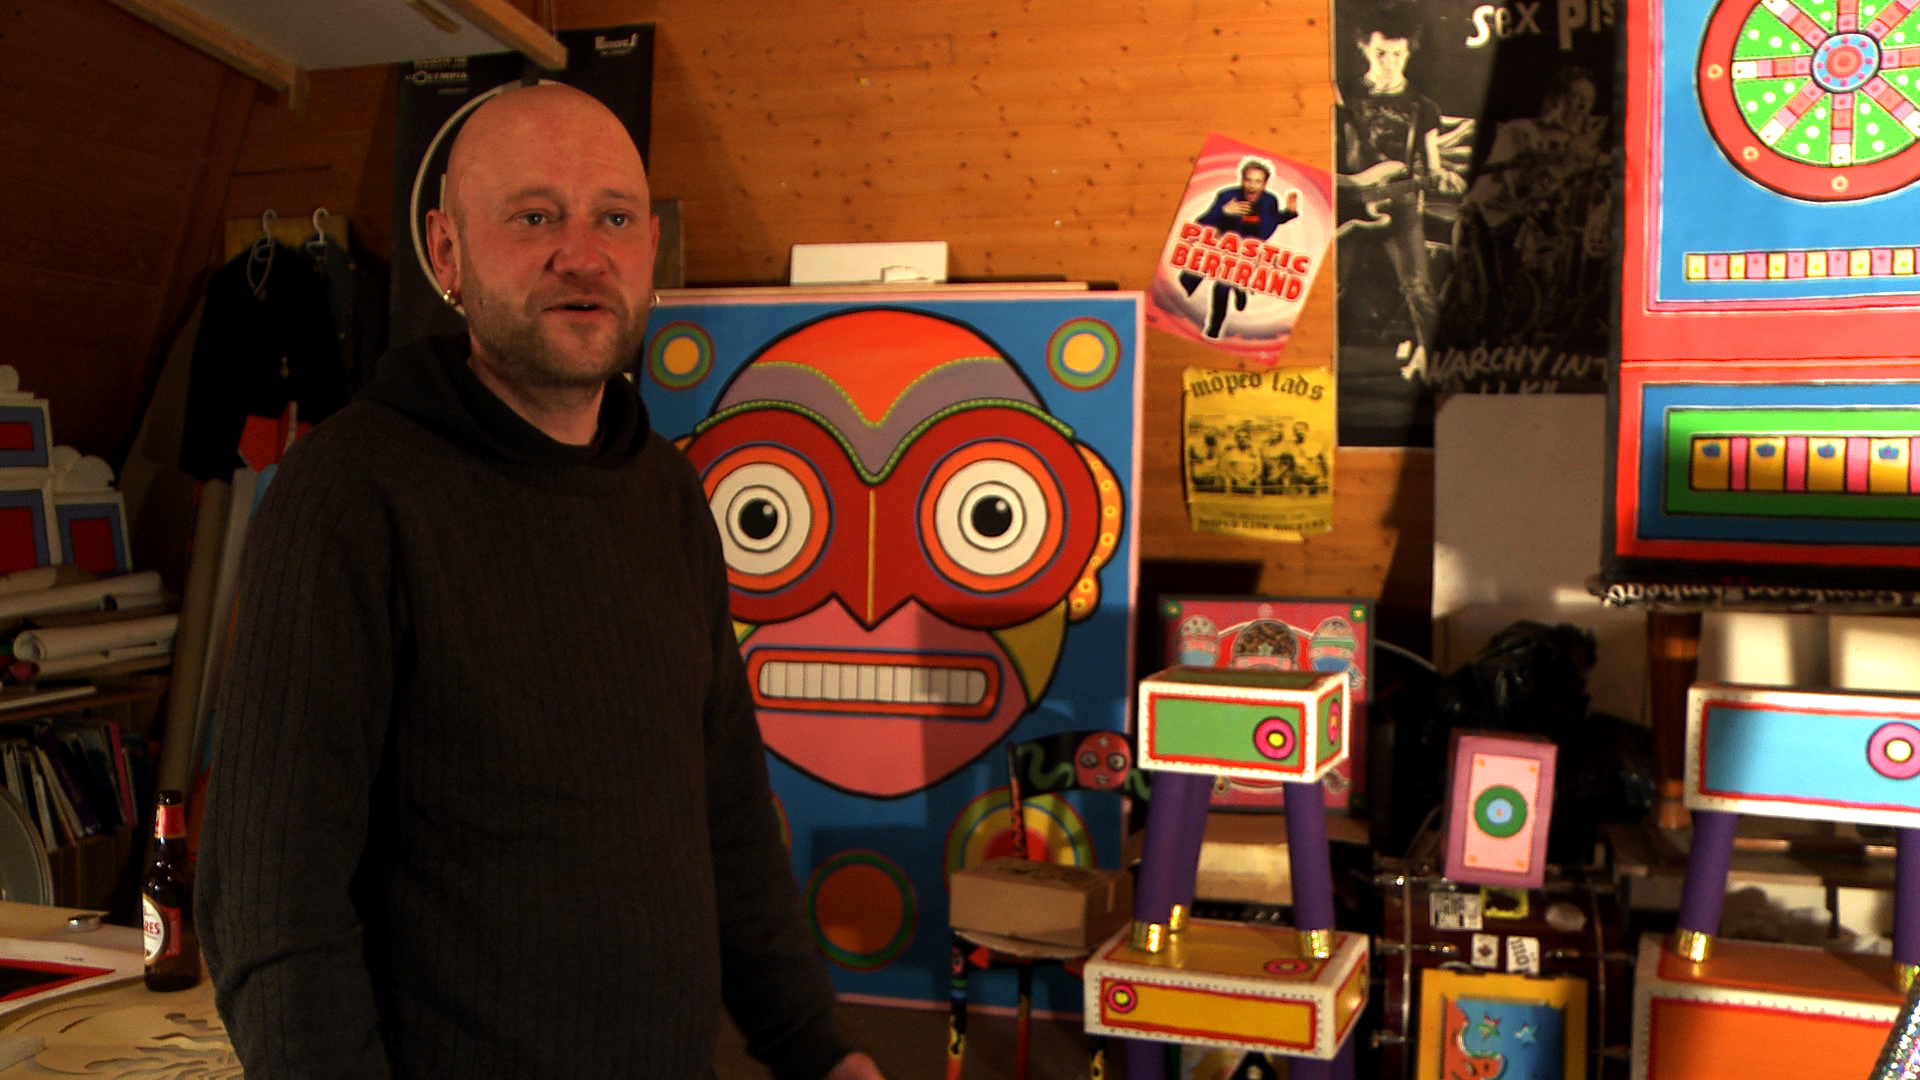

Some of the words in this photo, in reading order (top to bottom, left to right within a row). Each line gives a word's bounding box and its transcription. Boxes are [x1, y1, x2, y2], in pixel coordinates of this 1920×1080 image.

[1180, 222, 1312, 274] PLASTIC
[1170, 243, 1304, 301] BERTRAND
[1272, 371, 1324, 400] lads
[144, 921, 160, 934] RES
